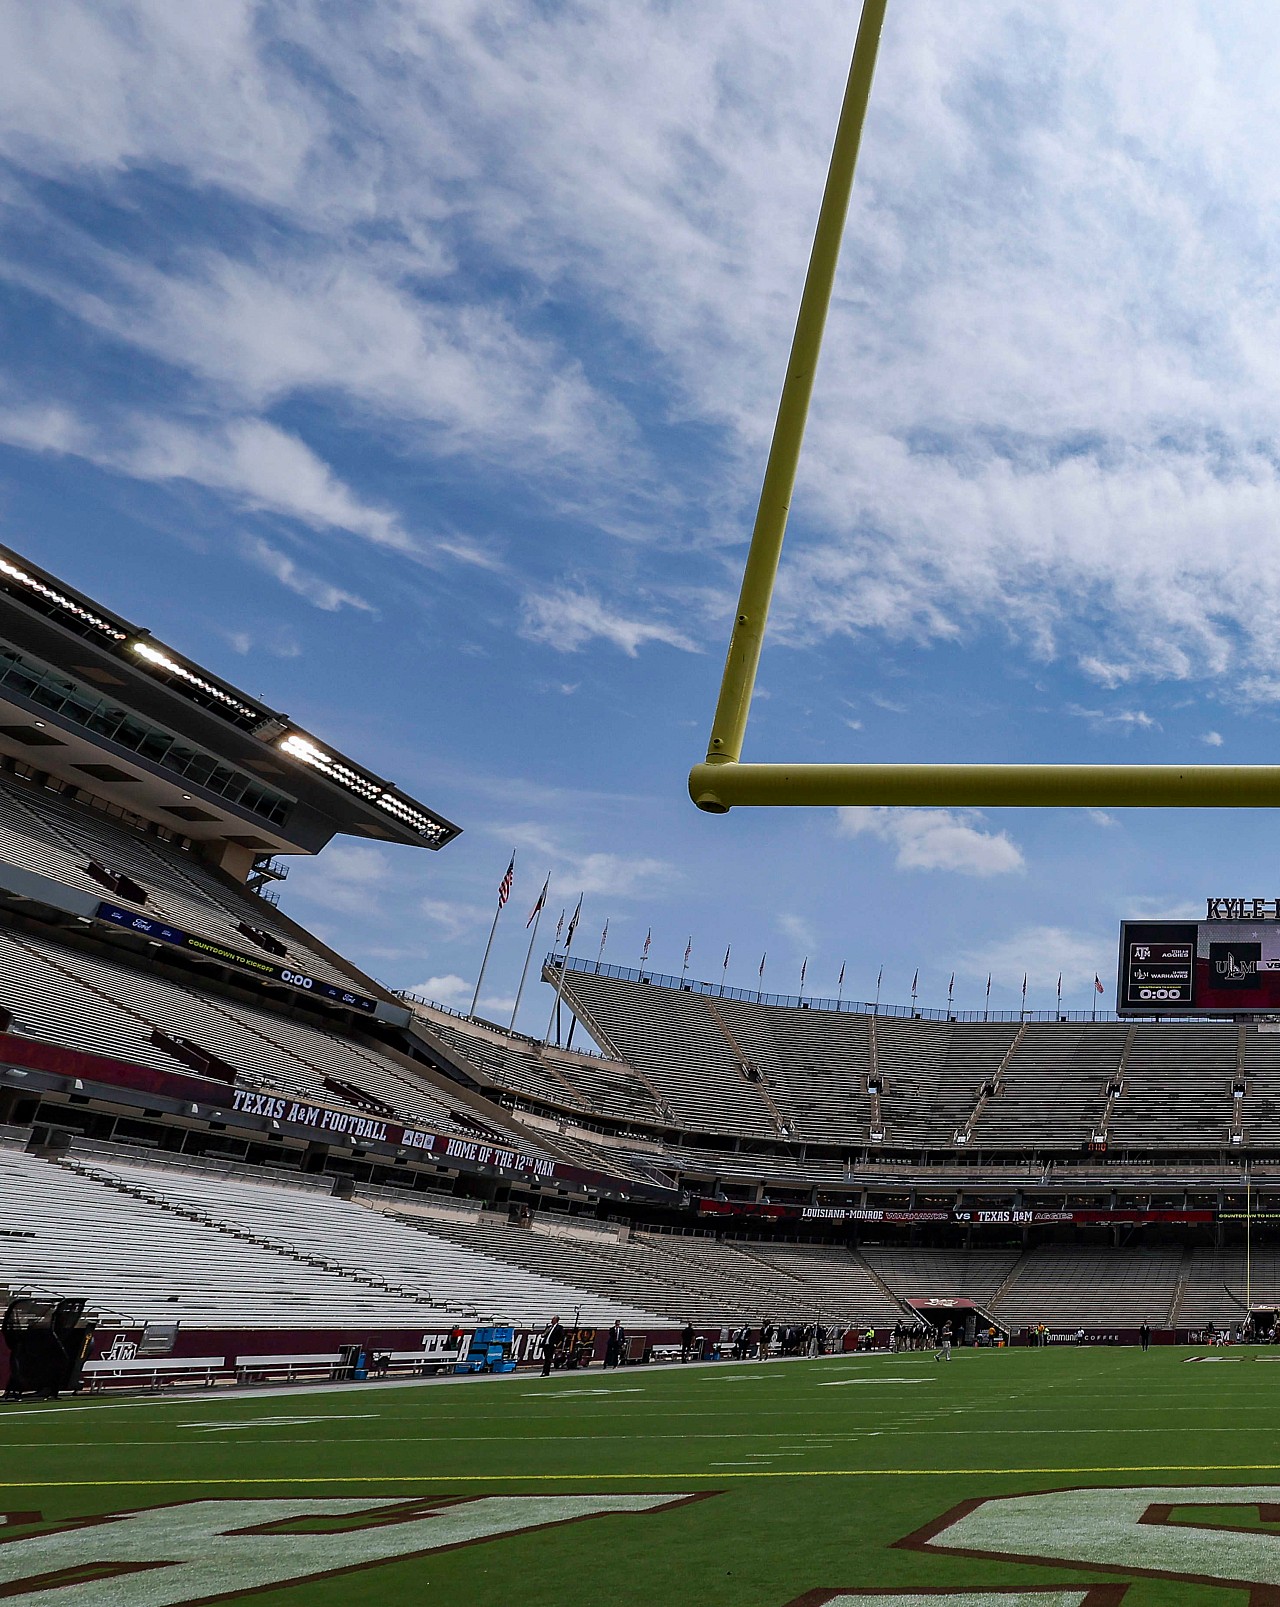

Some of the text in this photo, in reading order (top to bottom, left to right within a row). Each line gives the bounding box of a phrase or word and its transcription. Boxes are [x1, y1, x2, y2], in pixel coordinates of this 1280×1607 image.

[1207, 898, 1265, 919] KYLE
[132, 918, 152, 931] Ford
[188, 939, 274, 973] COUNTDOWN TO KICKOFF
[281, 970, 312, 989] 0:00
[1139, 989, 1181, 1000] 0:00
[232, 1089, 387, 1142] TEXAS A&M FOOTBALL
[445, 1138, 555, 1177] HOME OF THE 12TH MAN
[802, 1207, 884, 1220] LOUISIANA-MONROE
[955, 1212, 971, 1220] VS
[977, 1211, 1010, 1222] TEXAS
[1012, 1211, 1033, 1222] A&M
